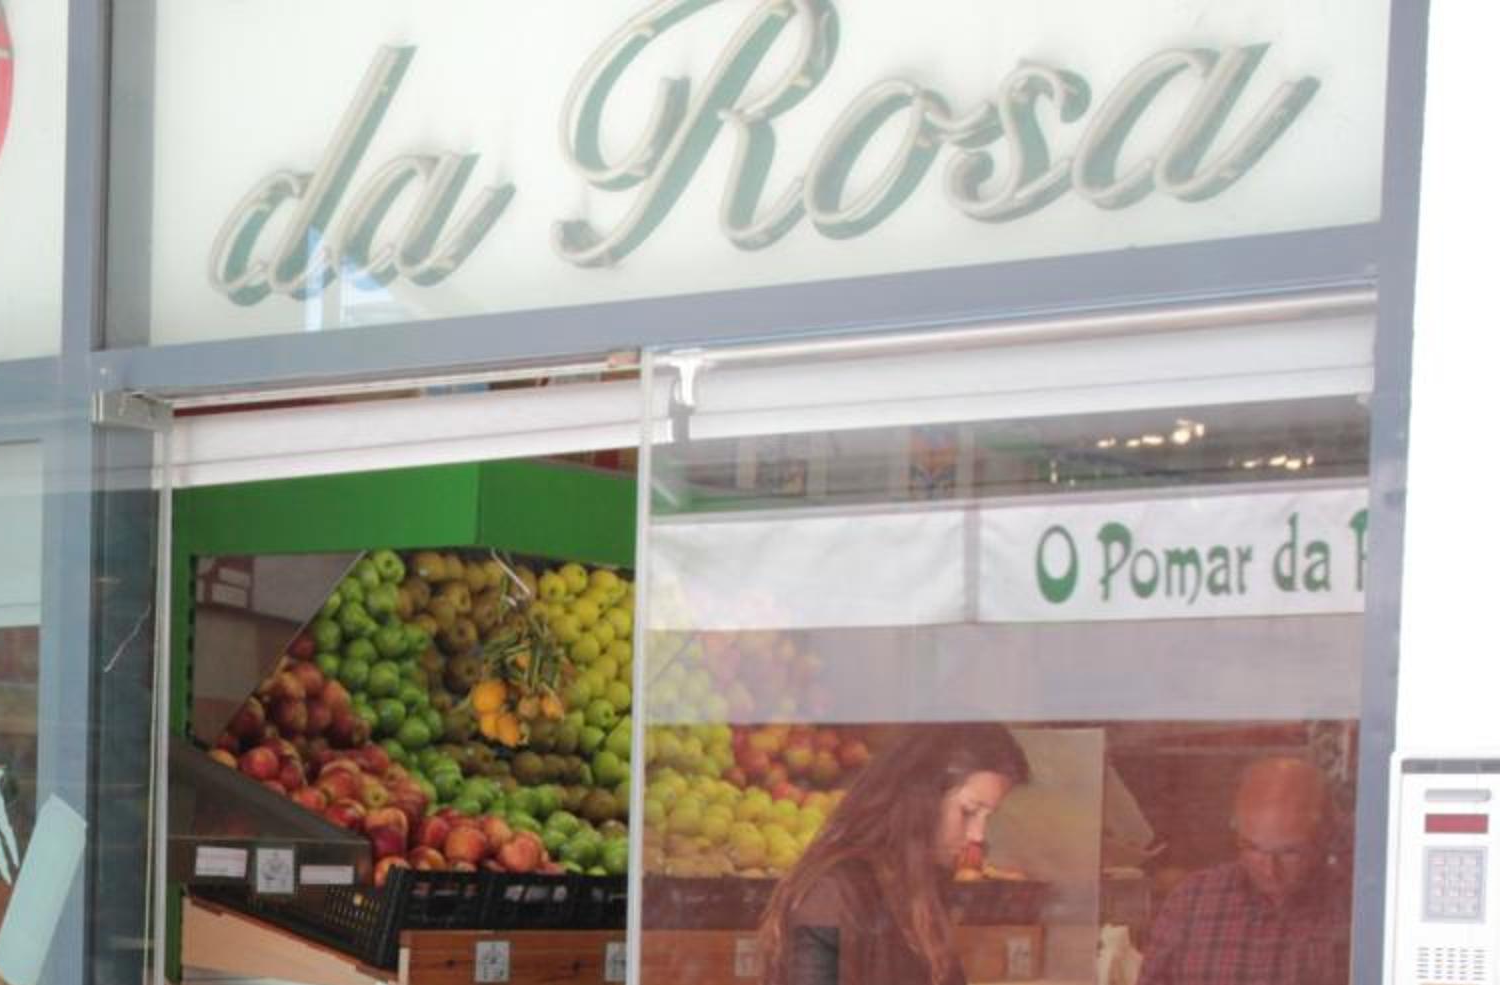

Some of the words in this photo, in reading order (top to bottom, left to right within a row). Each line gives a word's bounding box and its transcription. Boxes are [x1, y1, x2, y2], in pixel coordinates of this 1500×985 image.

[207, 44, 514, 305] da
[550, 0, 1321, 267] Rosa
[1036, 524, 1079, 604] O
[1097, 521, 1253, 605] Pomar
[1273, 511, 1331, 593] da
